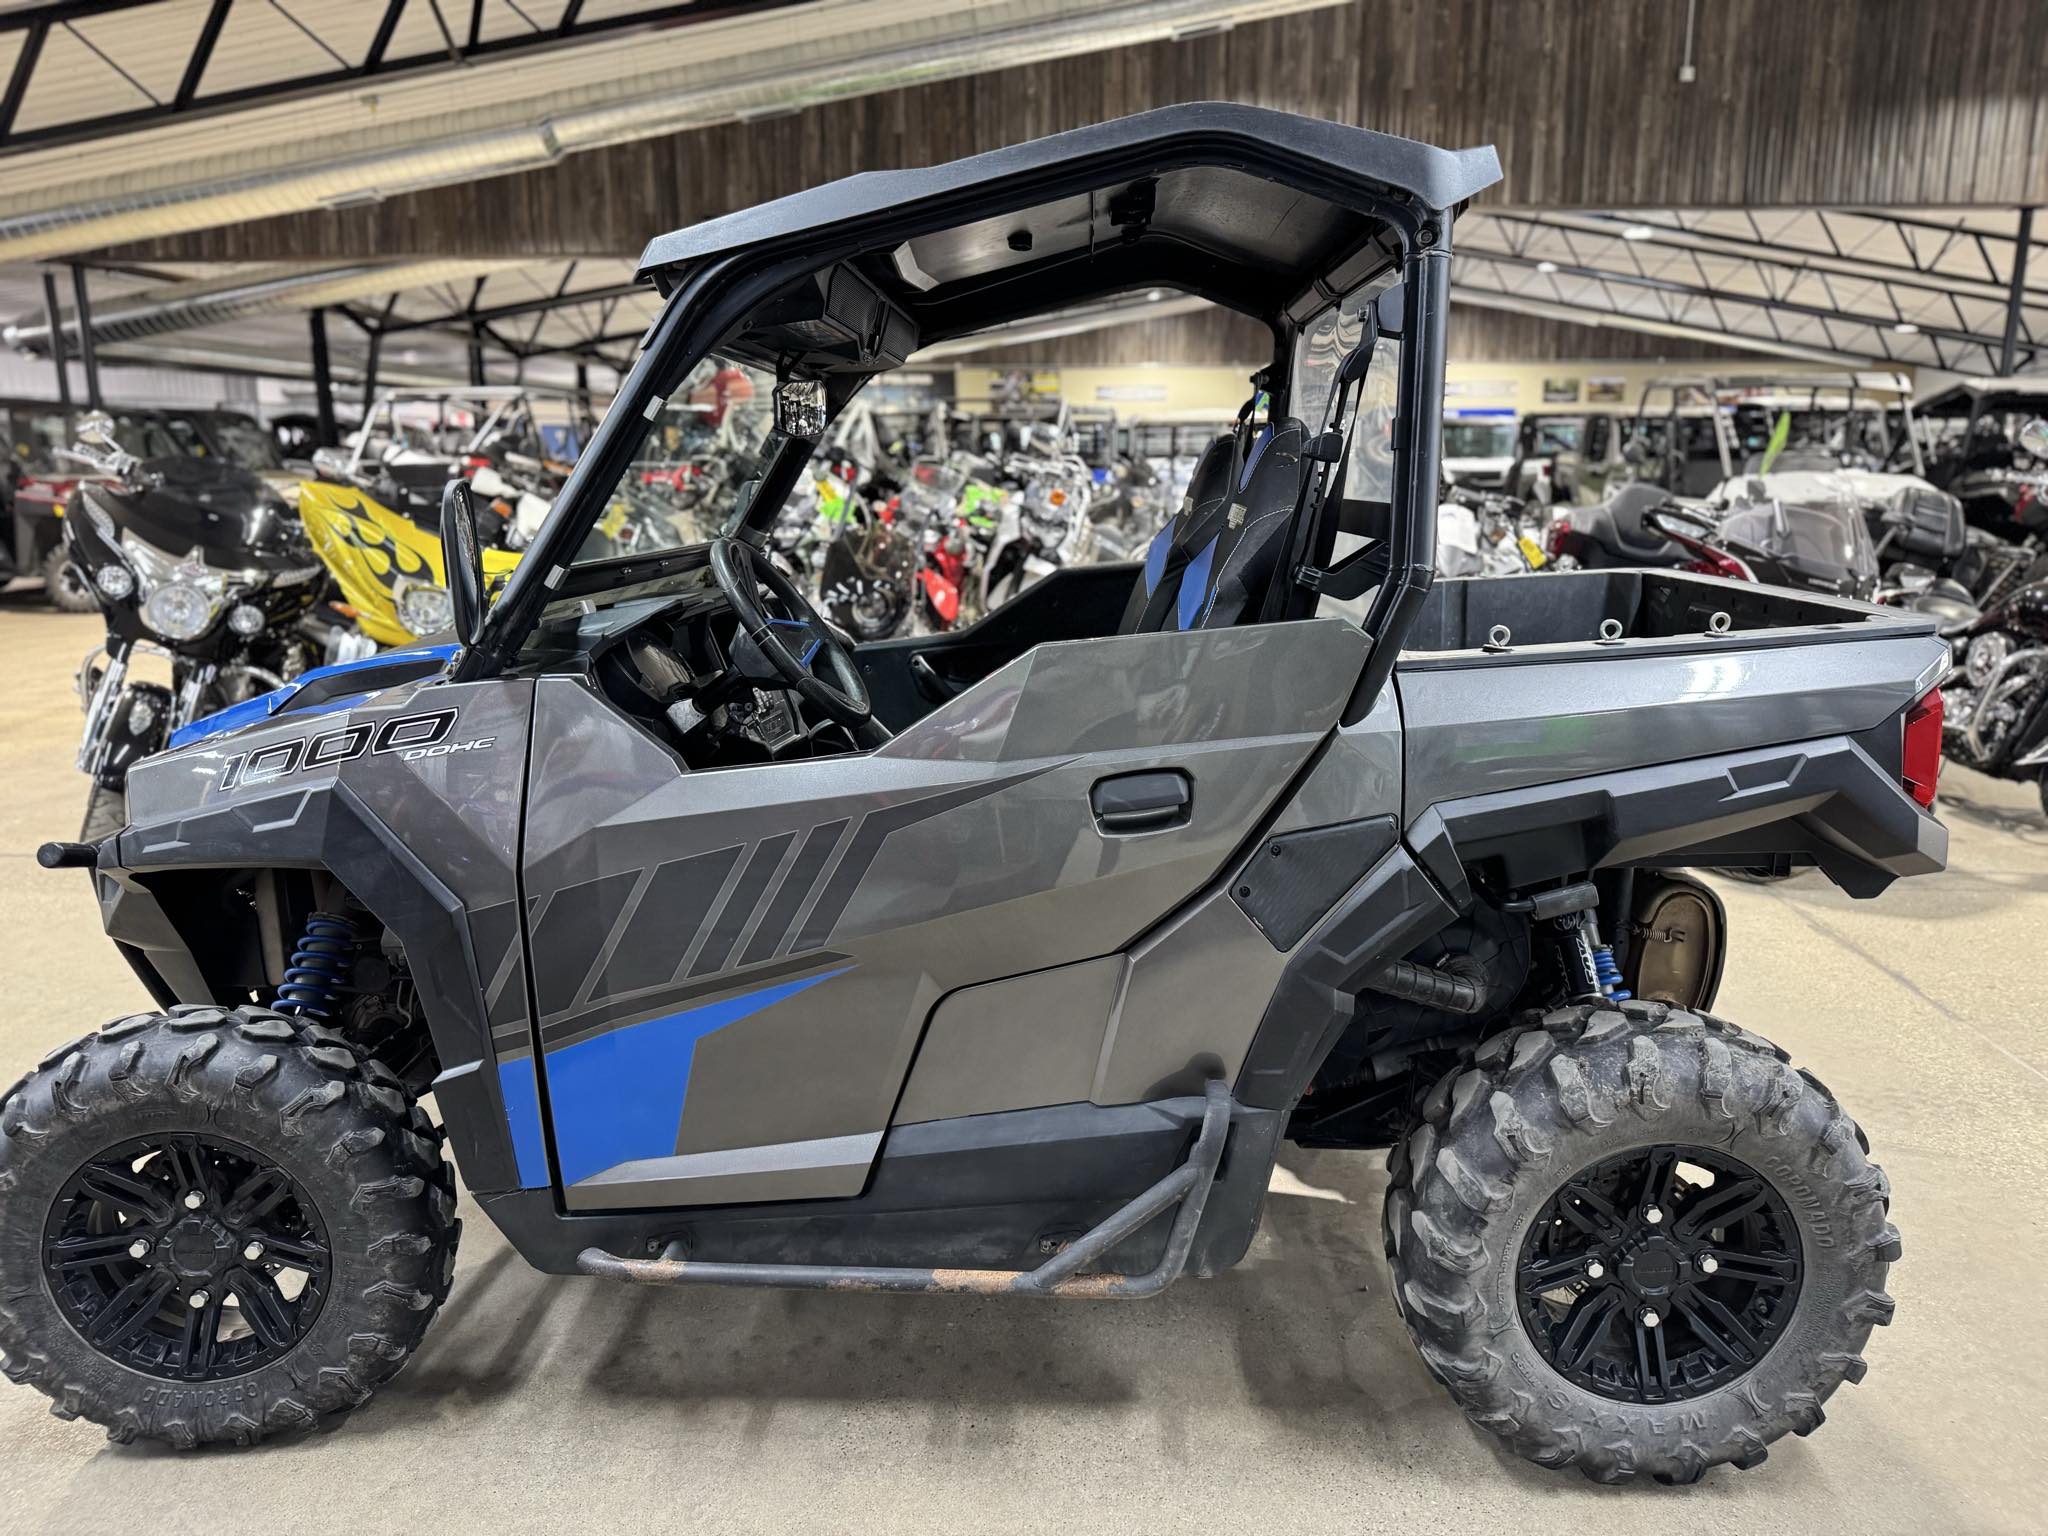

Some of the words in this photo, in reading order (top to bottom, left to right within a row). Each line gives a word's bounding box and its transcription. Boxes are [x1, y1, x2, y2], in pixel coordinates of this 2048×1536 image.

[218, 706, 460, 792] 1000
[402, 736, 497, 762] DOHC
[1765, 1155, 1835, 1248] CORONADO
[1548, 1389, 1706, 1435] MAXXS
